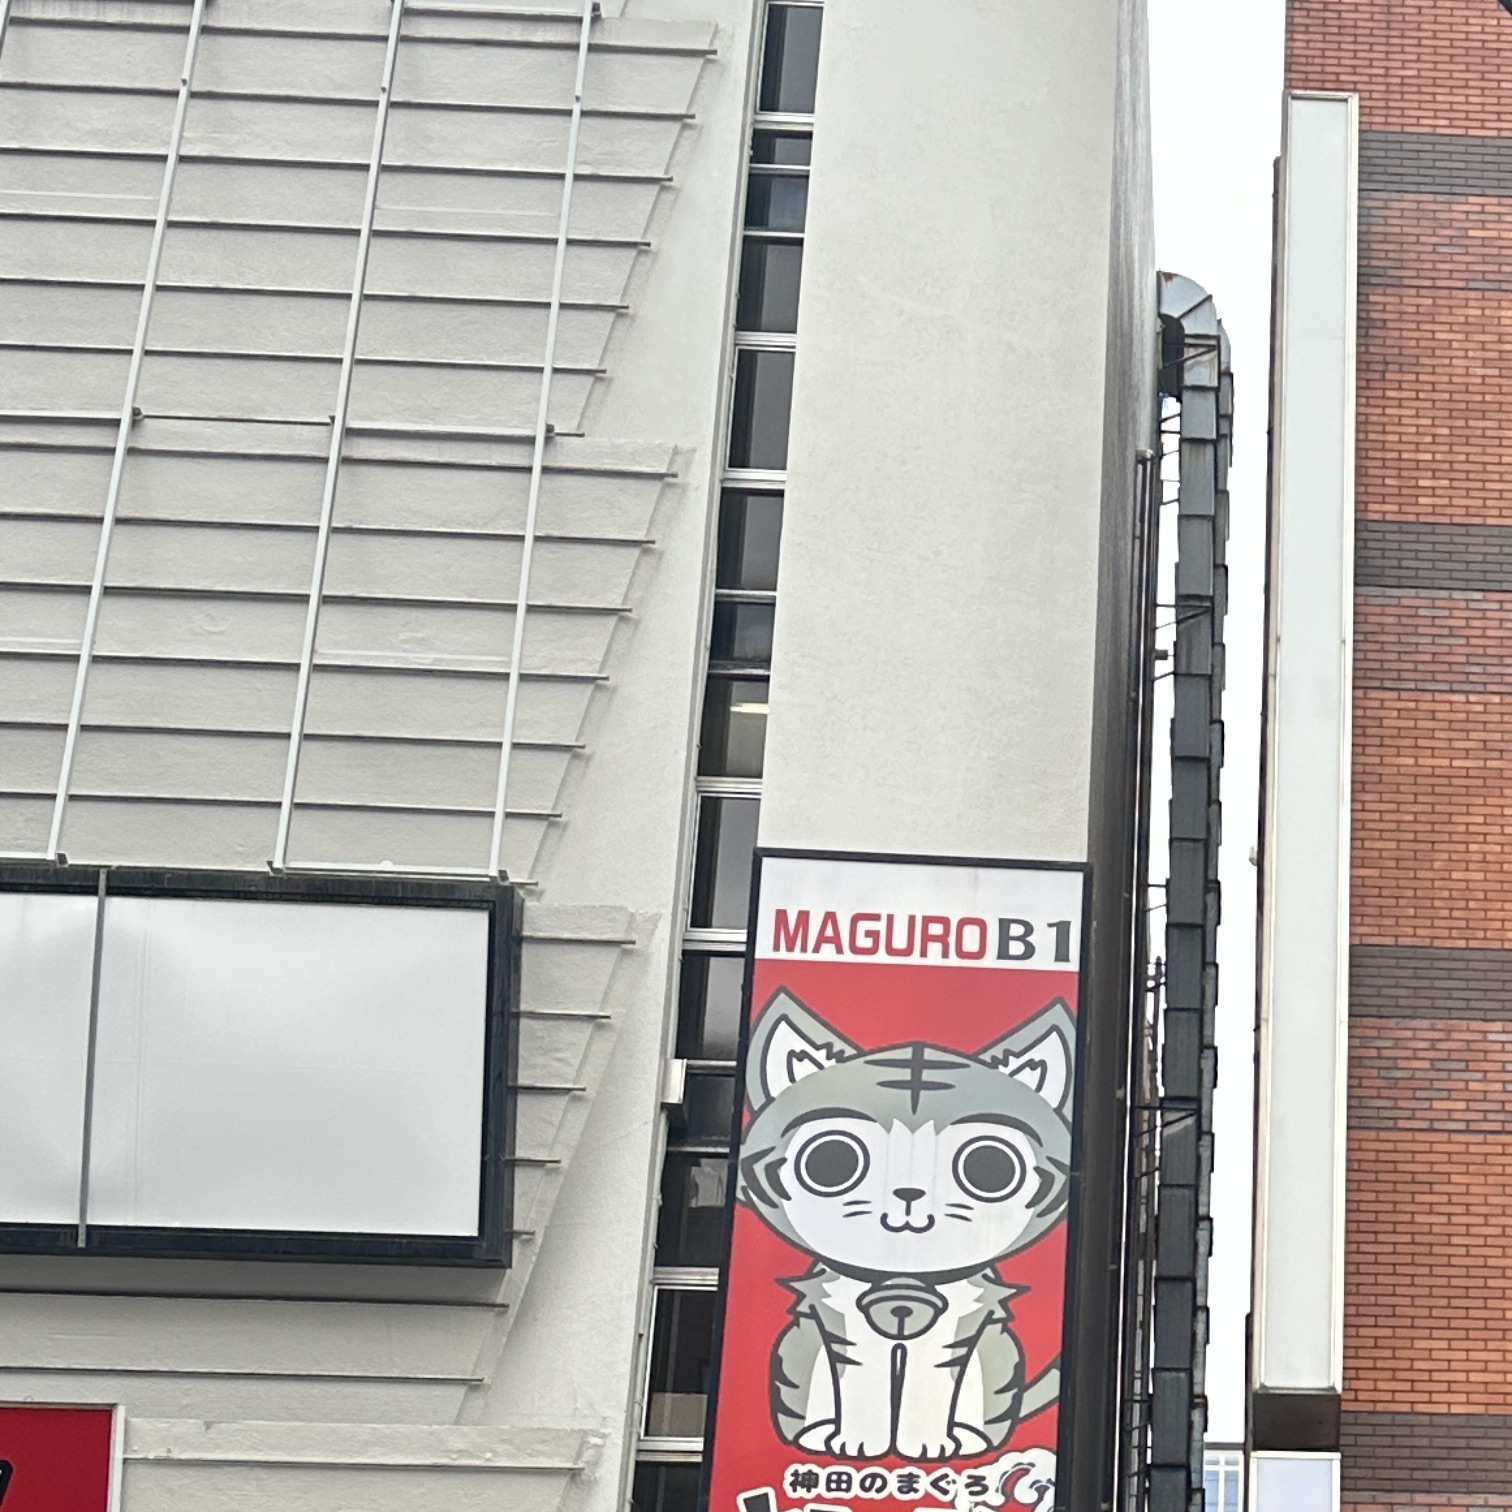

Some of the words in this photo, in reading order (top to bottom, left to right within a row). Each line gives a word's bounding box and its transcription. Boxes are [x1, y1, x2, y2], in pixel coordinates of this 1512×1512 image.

[772, 909, 988, 960] MAGURO
[996, 917, 1073, 963] B1
[788, 1468, 991, 1497] 神田のまぐろ
